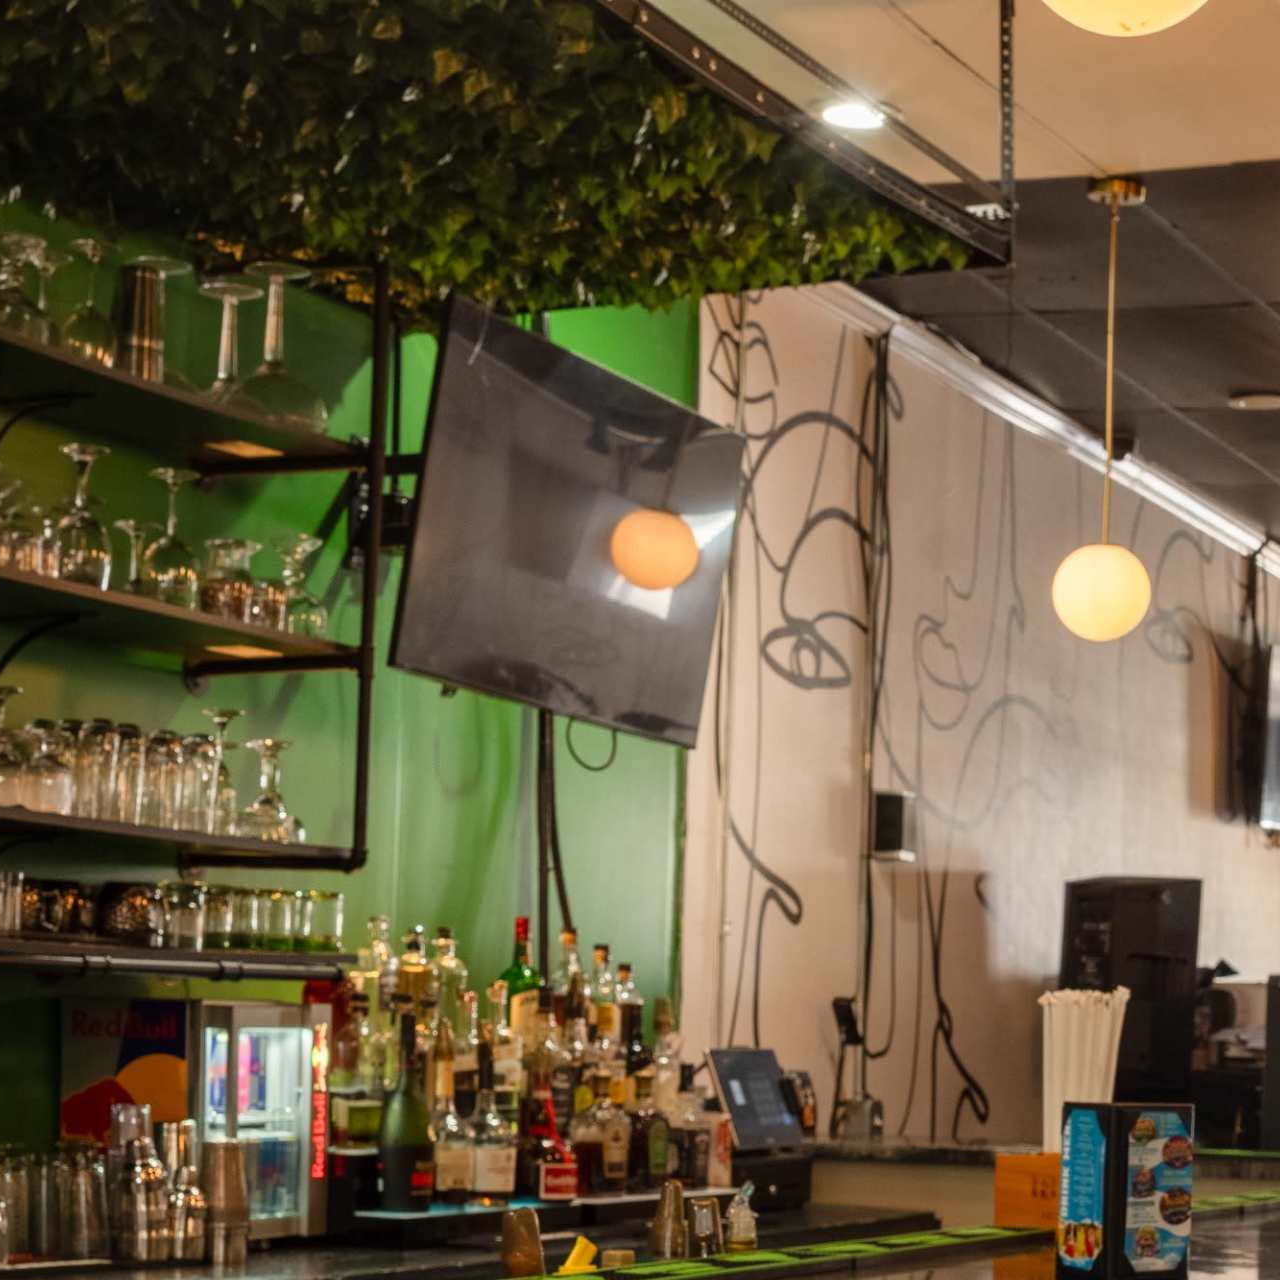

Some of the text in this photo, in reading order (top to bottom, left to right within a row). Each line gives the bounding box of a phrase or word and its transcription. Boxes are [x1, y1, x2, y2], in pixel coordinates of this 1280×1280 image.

[71, 1007, 177, 1039] Red Bull
[311, 1091, 327, 1180] Red Bull
